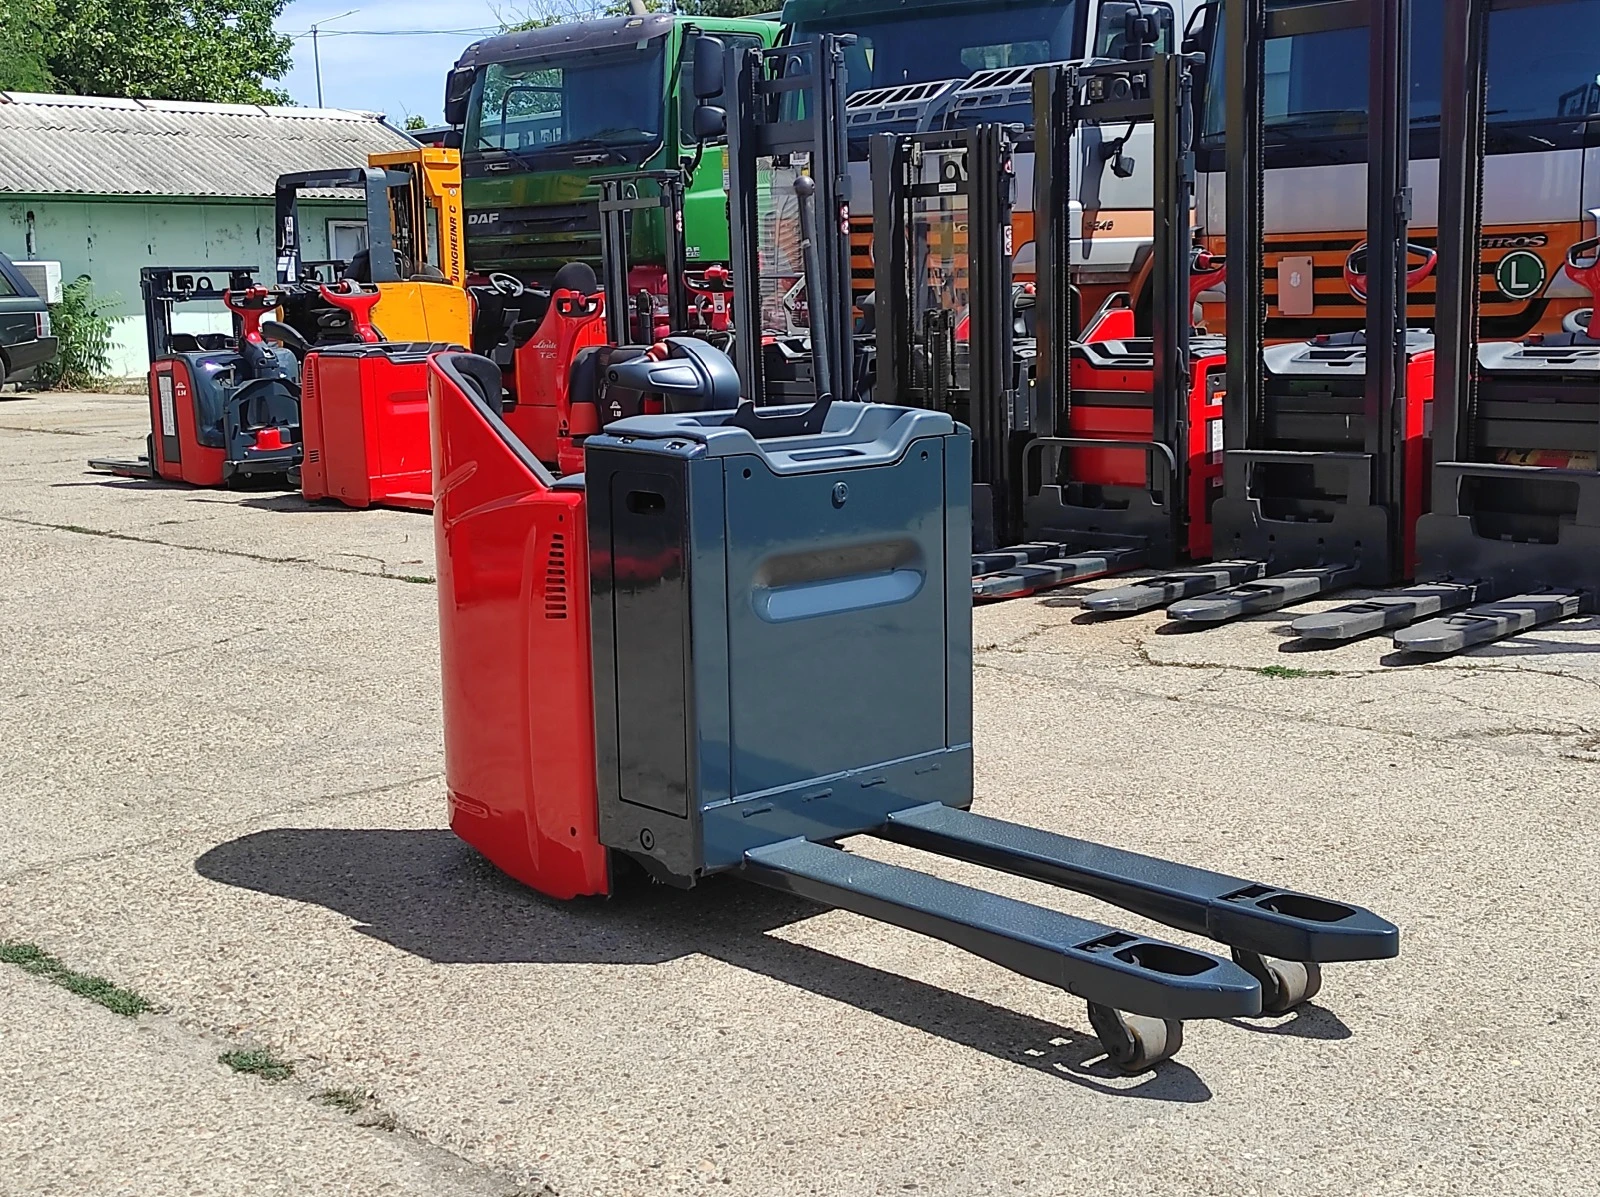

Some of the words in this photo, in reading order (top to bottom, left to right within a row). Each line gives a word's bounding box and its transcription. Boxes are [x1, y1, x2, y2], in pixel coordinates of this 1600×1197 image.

[468, 213, 499, 224] DAF
[1510, 261, 1529, 289] L
[532, 339, 557, 349] Linde
